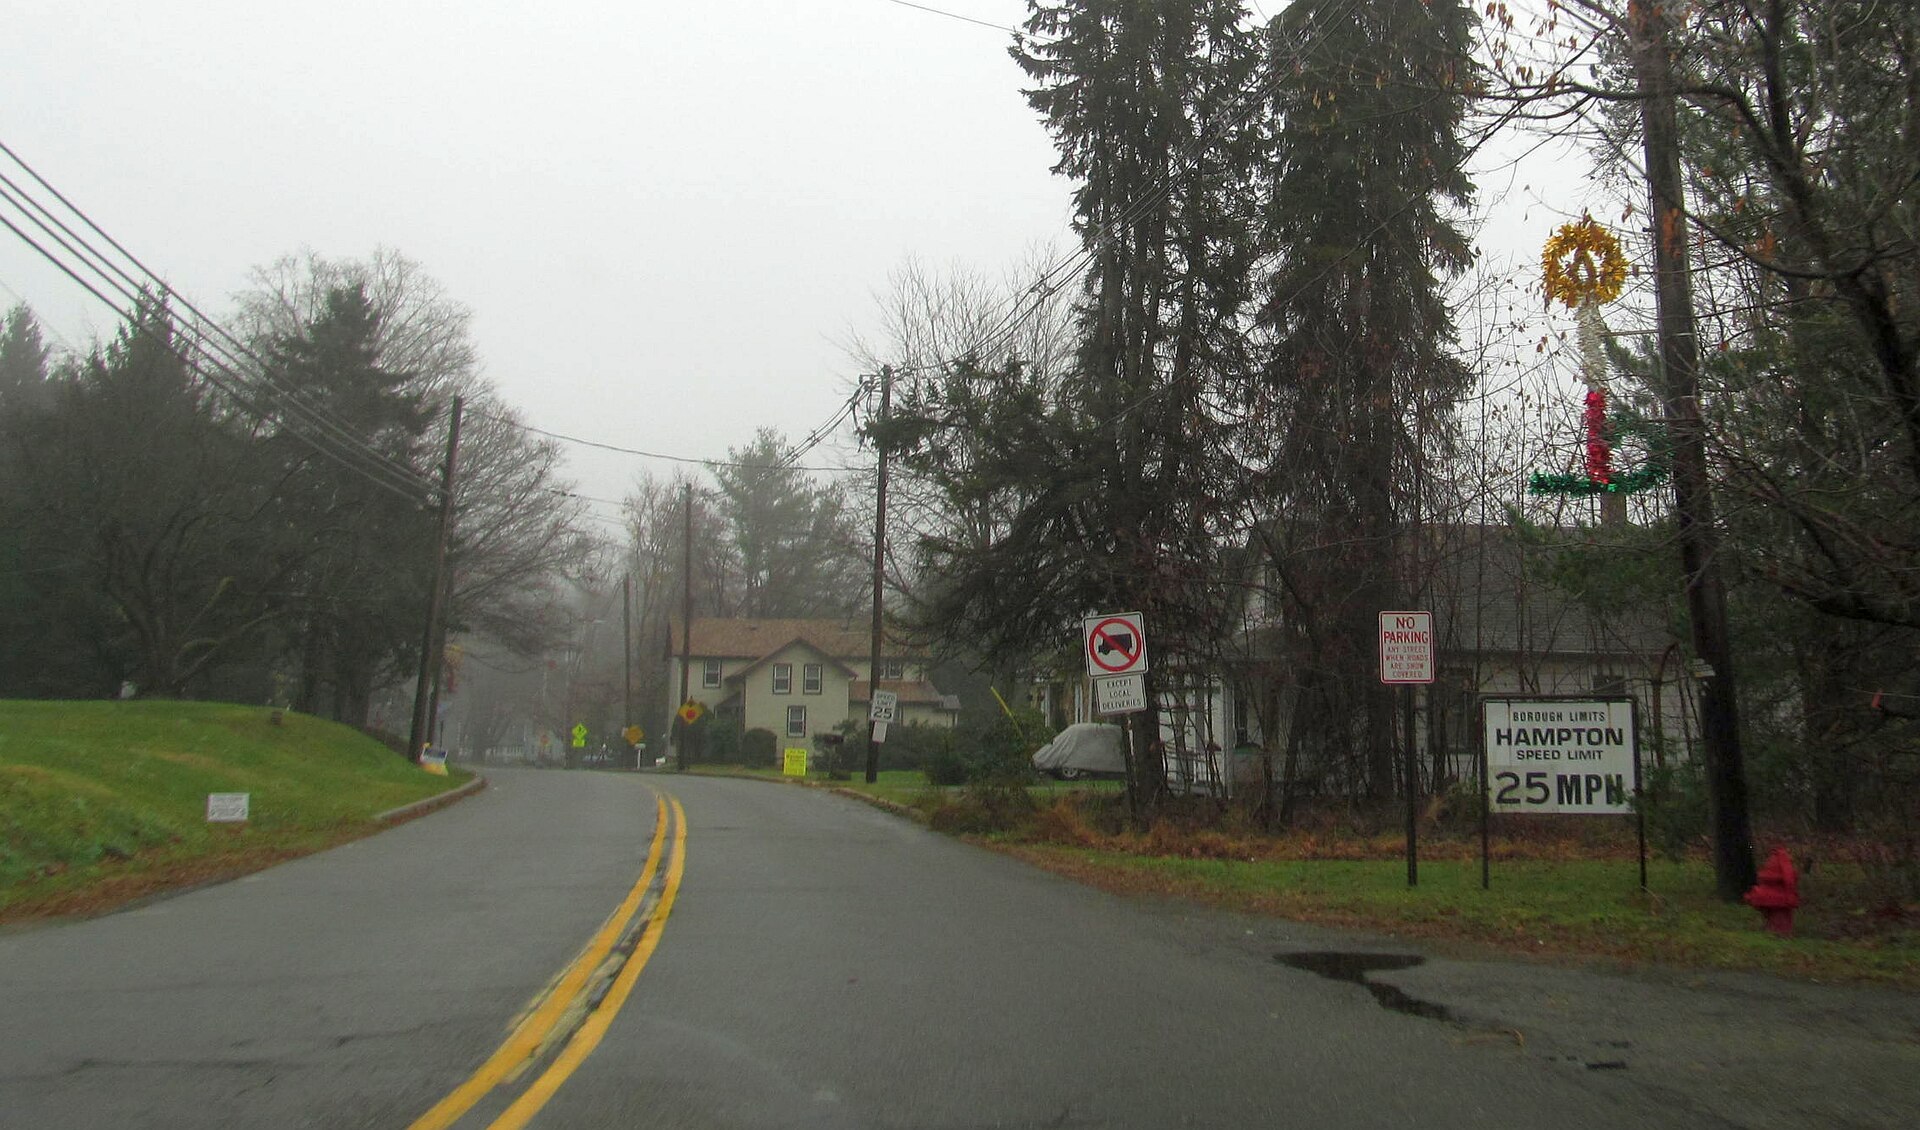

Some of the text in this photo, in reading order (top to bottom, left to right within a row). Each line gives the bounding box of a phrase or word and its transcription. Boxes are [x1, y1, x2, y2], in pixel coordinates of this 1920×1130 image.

[1396, 617, 1415, 629] NO
[1384, 631, 1428, 643] PARKING
[1106, 678, 1132, 688] EXCEPT
[1109, 690, 1131, 699] LOCAL
[1102, 699, 1142, 710] DELIVERIES
[874, 706, 892, 719] 25
[1513, 711, 1606, 722] BOROUGH LIMITS
[1496, 728, 1623, 746] HAMPTON
[1517, 750, 1604, 760] SPEED LIMIT
[1495, 771, 1550, 805] 25
